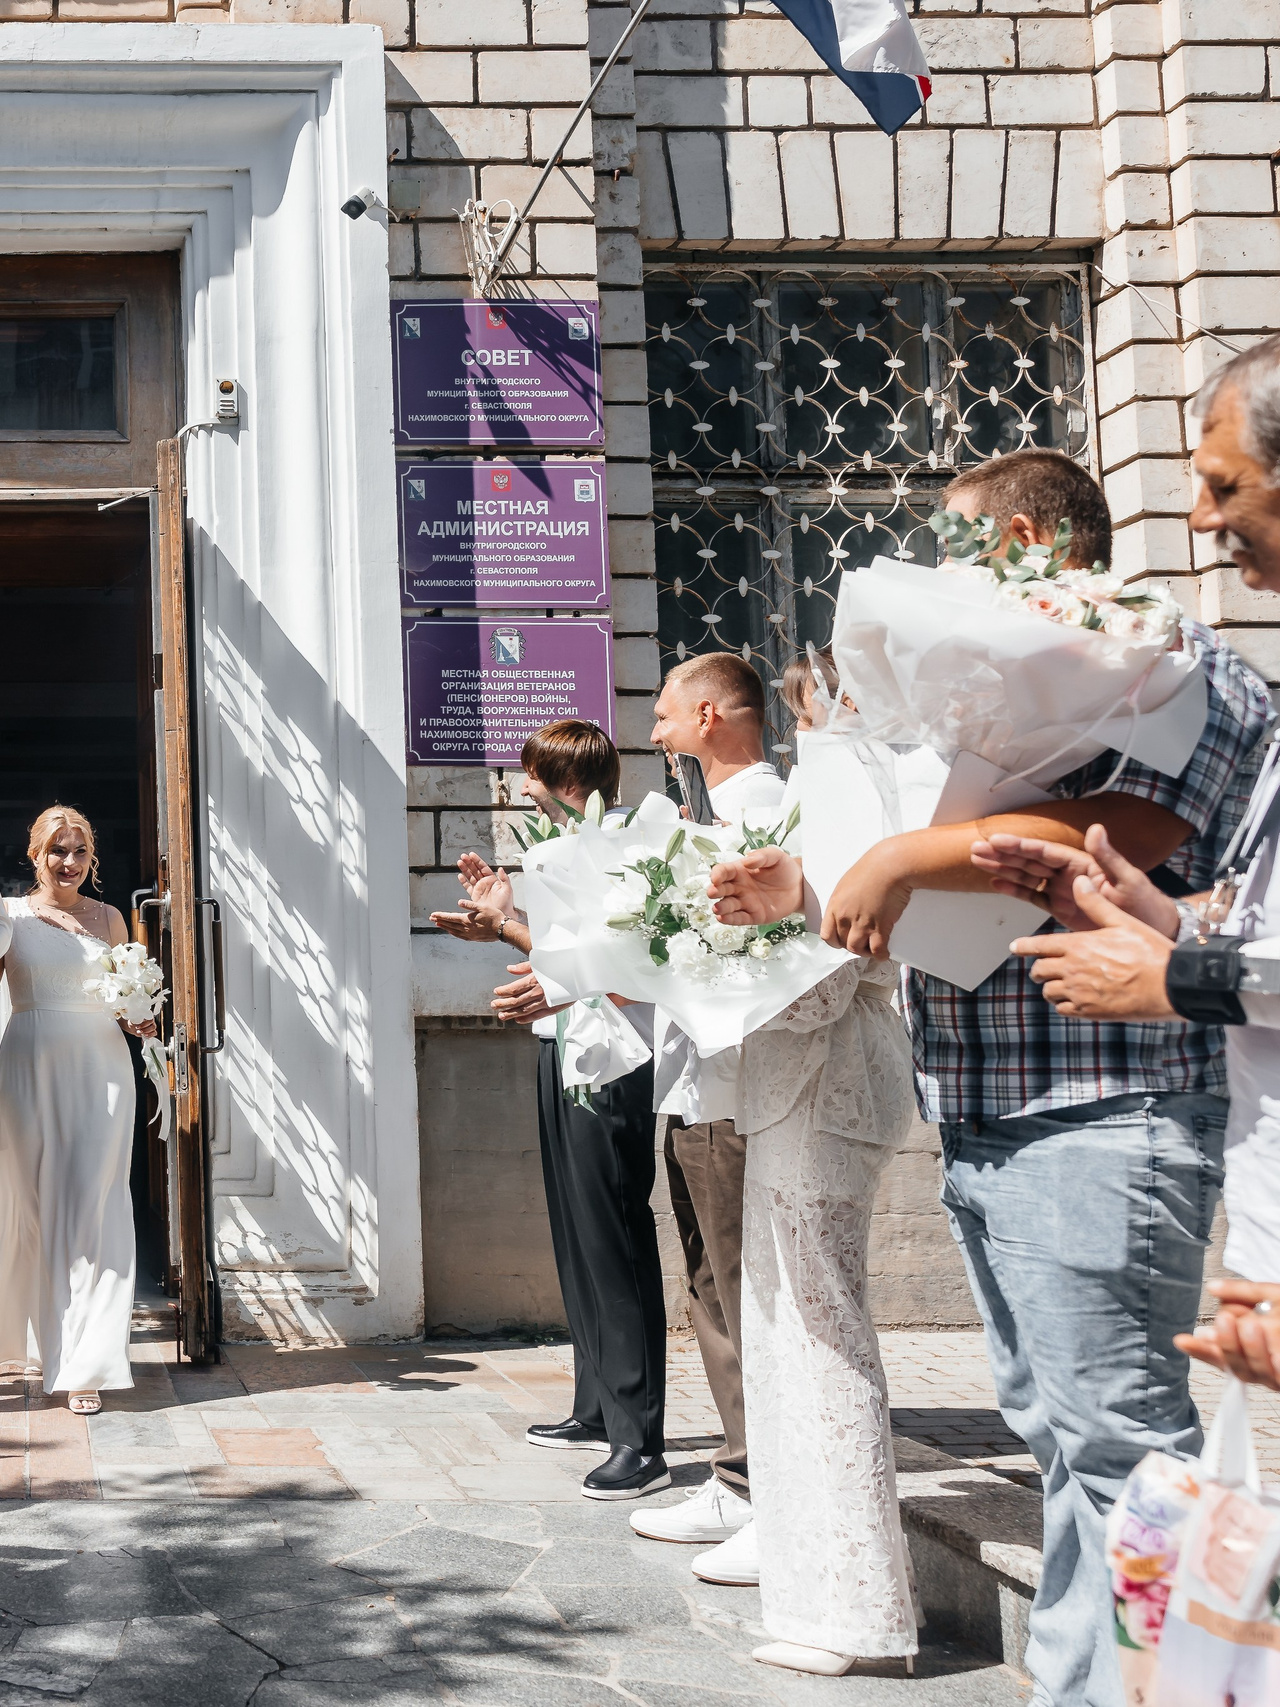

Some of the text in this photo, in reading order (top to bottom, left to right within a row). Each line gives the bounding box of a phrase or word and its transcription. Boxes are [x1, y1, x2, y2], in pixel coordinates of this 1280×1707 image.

[461, 349, 532, 366] СОВЕТ
[454, 377, 541, 386] ВНУТРИГОРОДСКОГО
[427, 390, 569, 399] МУНИЦИПАЛЬНОГО ОБРАЗОВАНИЯ
[471, 402, 532, 410] СЕВАСТОПОЛЯ
[408, 414, 589, 423] НАХИМОВСКОГО МУНИЦИПАЛЬНОГО ОКРУГА
[457, 500, 549, 515] МЕСТНАЯ
[417, 520, 590, 538] АДМИНИСТРАЦИЯ
[459, 542, 547, 550] ВНУТРИГОРОДСКОГО
[432, 554, 575, 563] МУНИЦИПАЛЬНОГО ОБРАЗОВАНИЯ
[477, 567, 538, 575] СЕВАСТОПОЛЯ
[413, 579, 596, 588] НАХИМОВСКОГО МУНИЦИПАЛЬНОГО ОКРУГА
[441, 669, 575, 680] МЕСТНАЯ ОБЩЕСТВЕННАЯ
[441, 682, 576, 692] ОРГАНИЗАЦИЯ ВЕТЕРАНОВ
[447, 693, 571, 704] (ПЕНСИОНЕРОВ) ВОЙНЫ,
[440, 706, 578, 716] ТРУДА, ВООРУЖЕННЫХ СИЛ
[420, 718, 427, 726] И
[429, 718, 550, 727] ПРАВООХРАНИТЕЛЬНЫХ
[420, 730, 502, 739] НАХИМОВСКОГО
[432, 742, 469, 751] ОКРУГА
[472, 743, 512, 753] ГОРОДА
